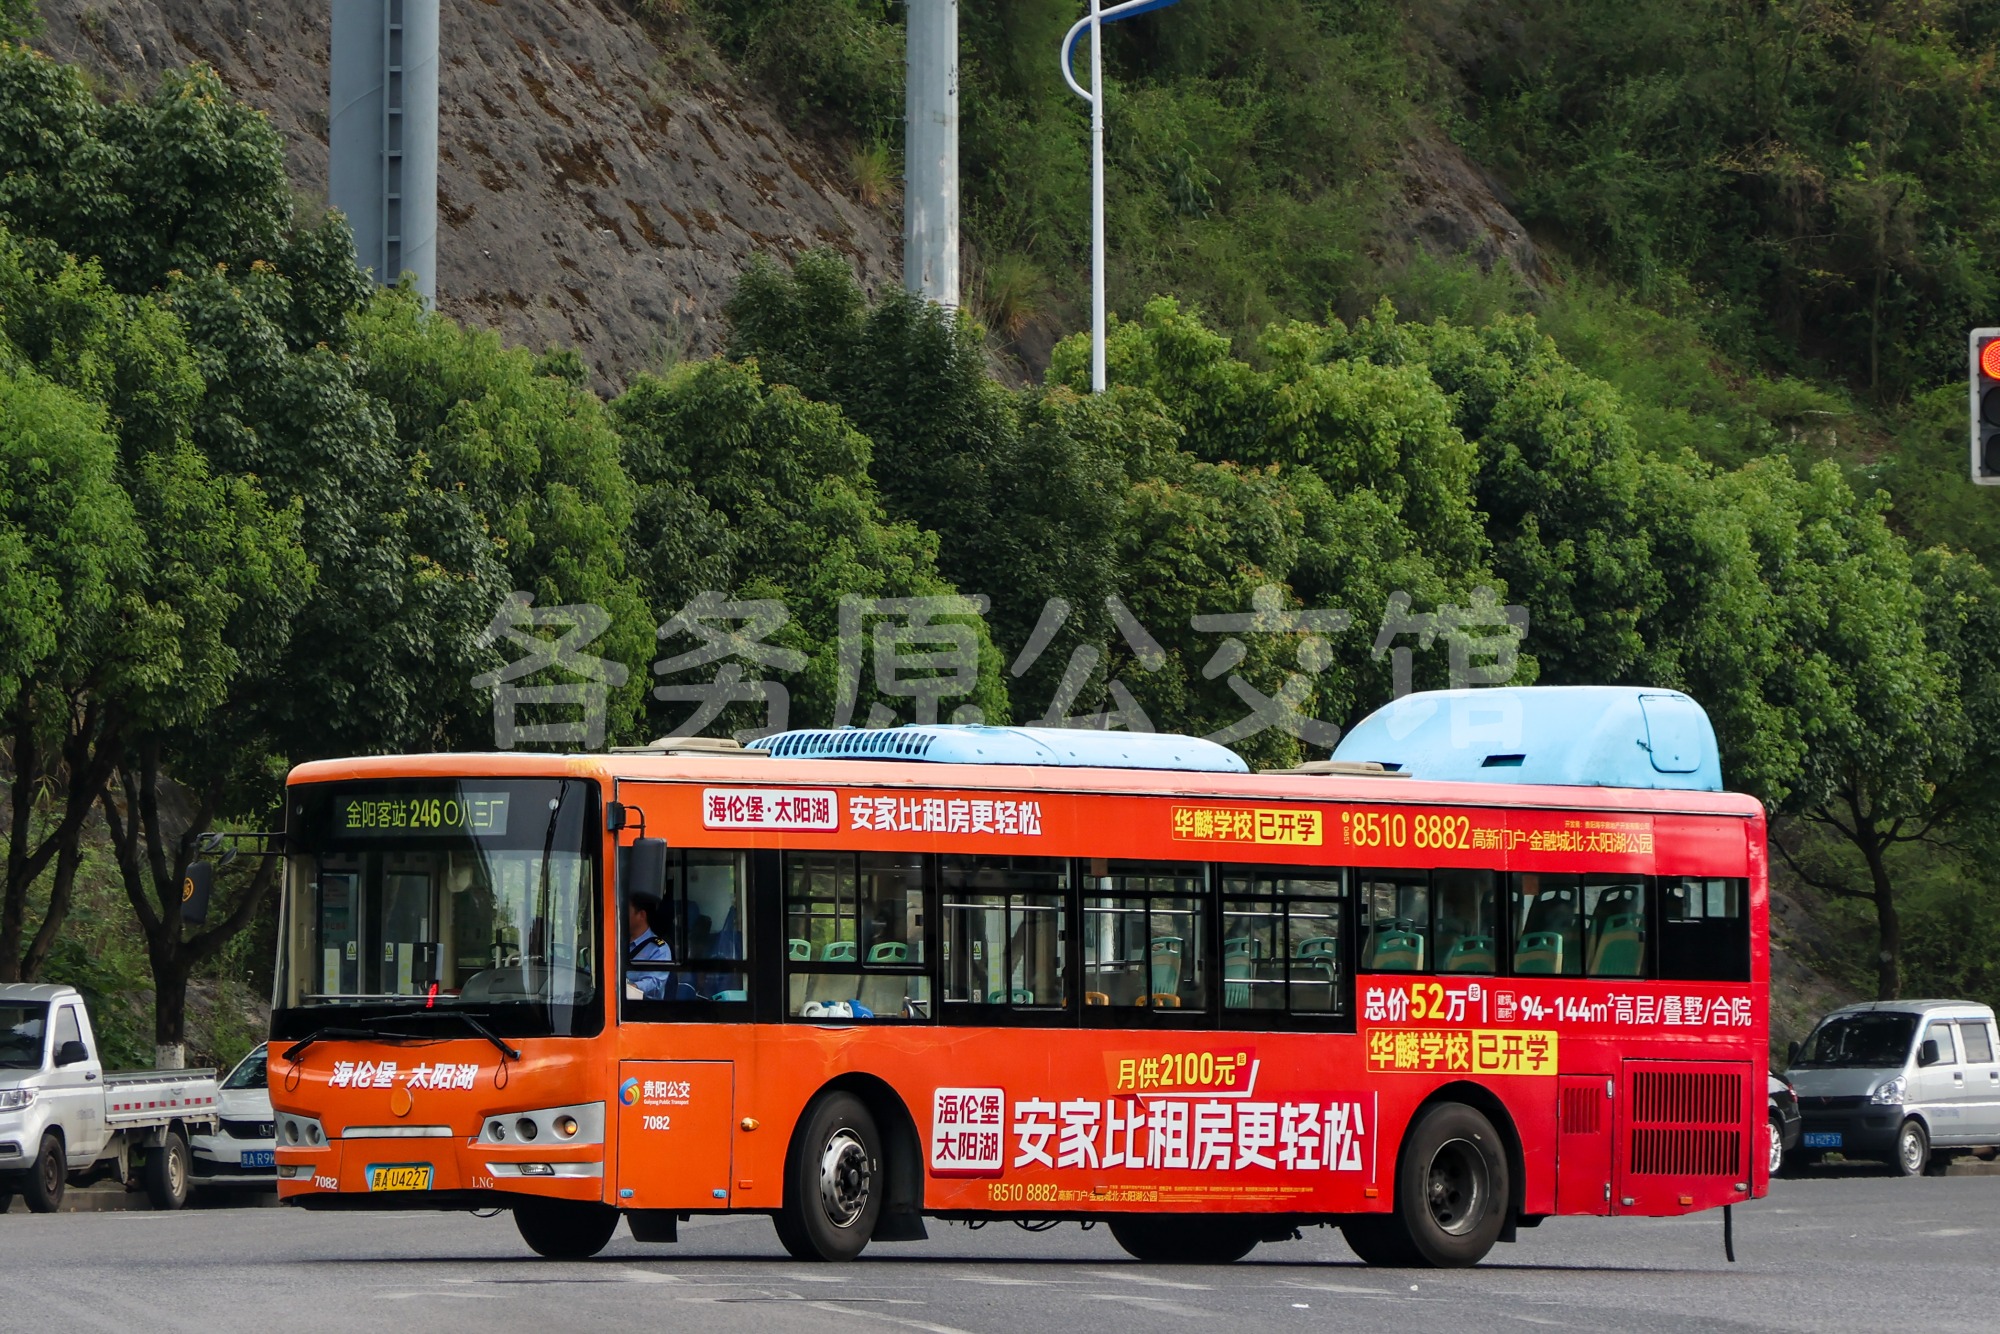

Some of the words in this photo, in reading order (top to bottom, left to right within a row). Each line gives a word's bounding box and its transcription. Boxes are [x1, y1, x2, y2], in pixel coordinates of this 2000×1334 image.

[346, 800, 406, 828] 金阳客站
[410, 799, 440, 827] 246
[708, 794, 829, 824] 海伦堡·太阳湖
[850, 795, 1042, 836] 安家比租房更轻松
[1353, 812, 1406, 847] 8510
[1414, 814, 1470, 849] 8882
[1472, 828, 1653, 854] 高新门户·金融城北·太阳湖公园
[328, 1061, 478, 1089] 海伦堡·太阳湖
[643, 1081, 690, 1098] 贵阳公交
[642, 1115, 670, 1130] 7082
[938, 1095, 999, 1124] 海伦堡
[936, 1131, 998, 1161] 太阳湖
[1013, 1096, 1364, 1171] 安家比租房更轻松
[314, 1175, 338, 1190] 7082
[472, 1176, 494, 1189] LNG
[993, 1183, 1023, 1201] 8510
[1026, 1183, 1058, 1202] 8882
